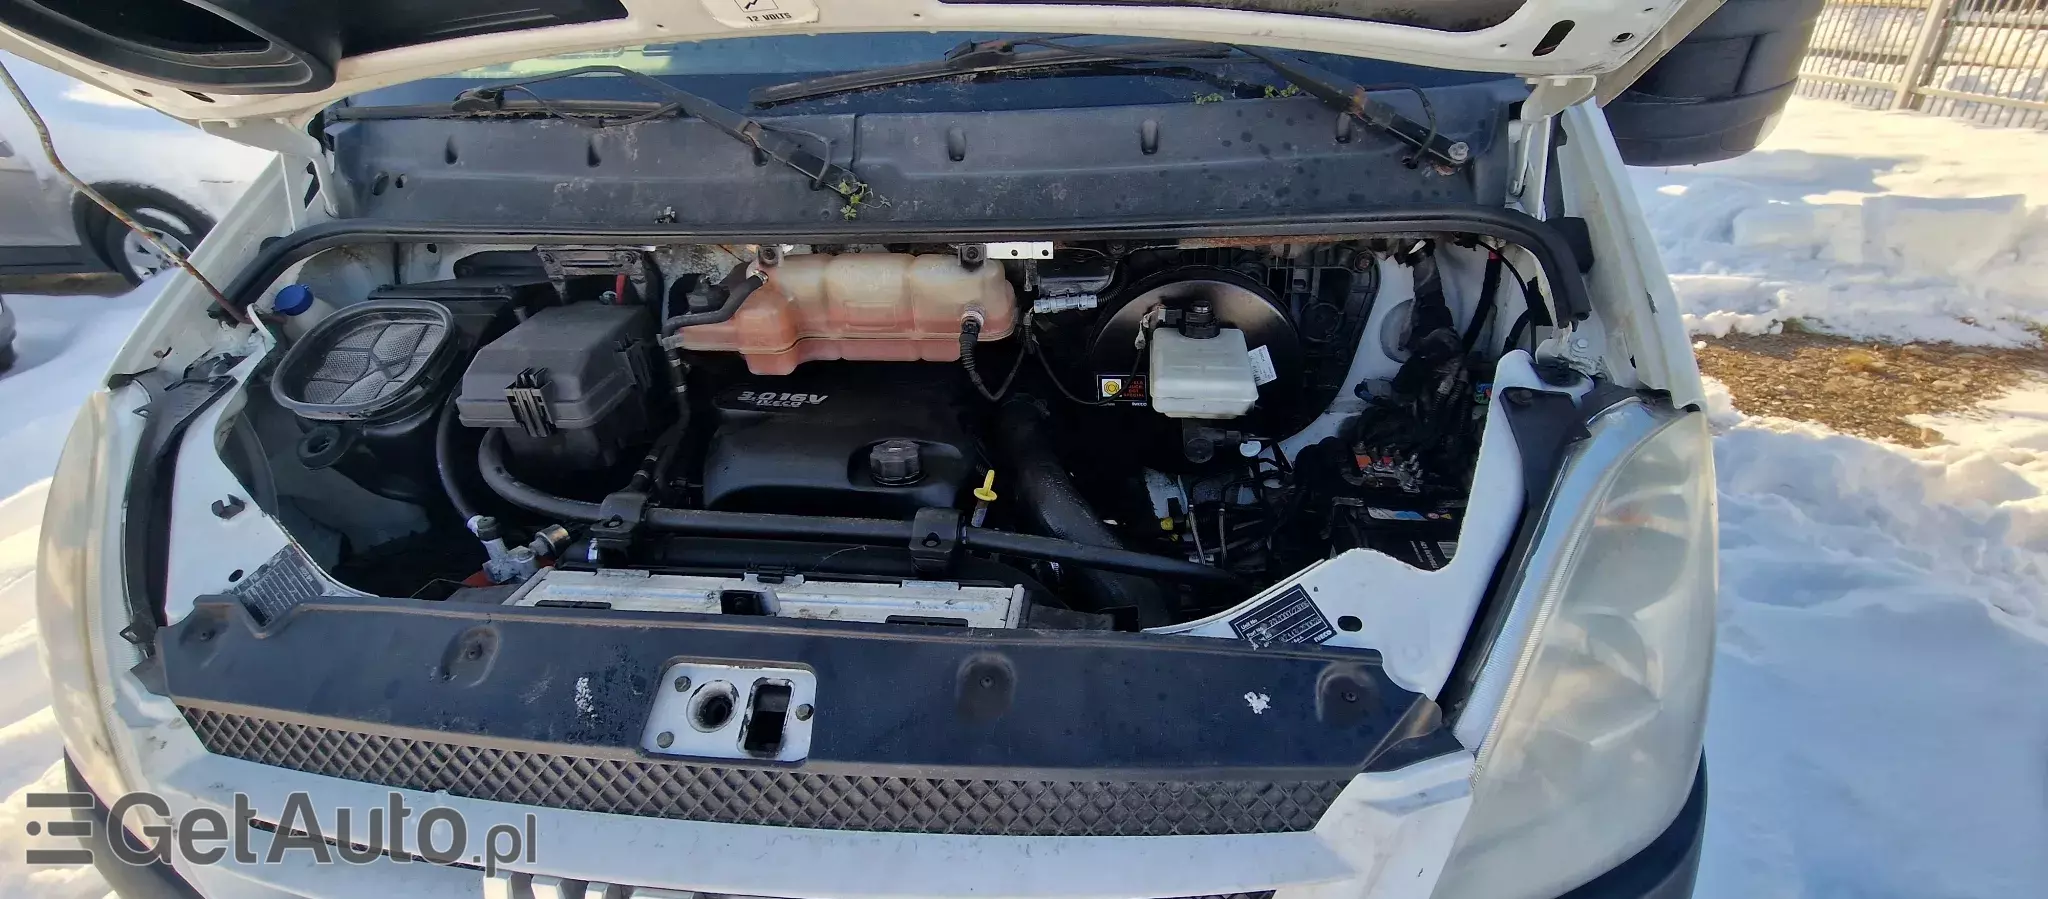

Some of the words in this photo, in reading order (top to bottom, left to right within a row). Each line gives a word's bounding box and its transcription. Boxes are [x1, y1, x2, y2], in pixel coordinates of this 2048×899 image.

[762, 12, 792, 21] VOLTS
[756, 400, 801, 408] IVECO
[1313, 629, 1333, 643] IVECO
